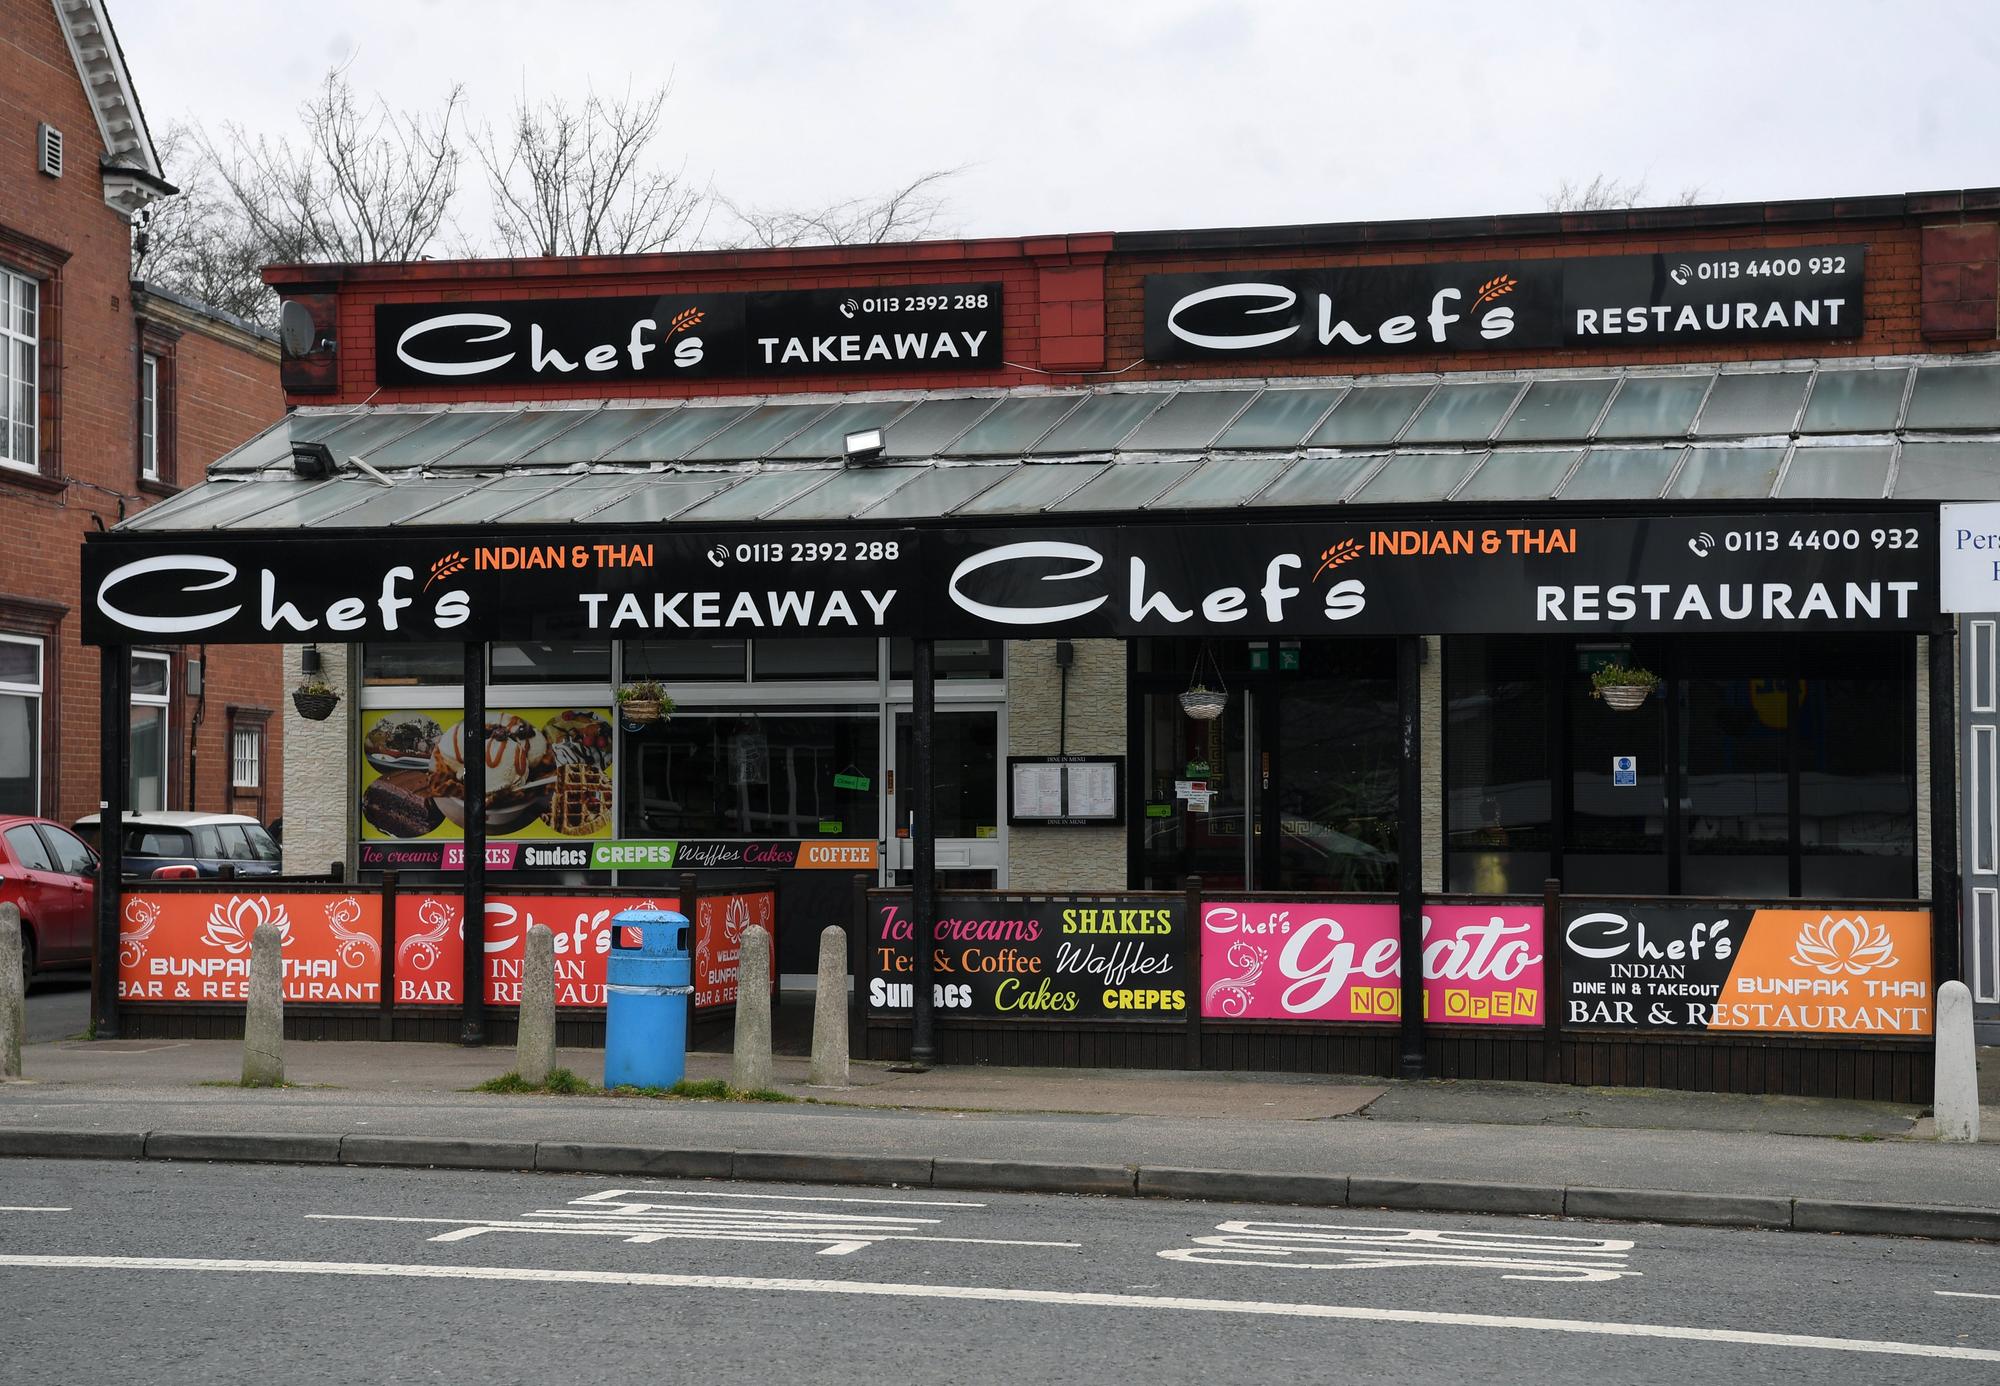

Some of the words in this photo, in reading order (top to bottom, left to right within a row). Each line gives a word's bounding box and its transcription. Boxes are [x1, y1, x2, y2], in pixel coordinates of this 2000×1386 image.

[1697, 260, 1741, 280] 0113
[1746, 258, 1801, 278] 4400
[1808, 256, 1847, 275] 932
[862, 297, 899, 313] 0113
[905, 296, 949, 312] 2392
[953, 294, 989, 310] 288
[1576, 297, 1846, 336] RESTAURANT
[758, 330, 987, 364] TAKEAWAY
[735, 542, 783, 563] 0113
[790, 541, 847, 562] 2392
[854, 540, 900, 560] 288
[1369, 529, 1467, 556] INDIAN
[1480, 528, 1502, 554] &
[1506, 528, 1577, 554] THAI
[1724, 530, 1779, 551] 0113
[1788, 529, 1860, 550] 4400
[1871, 528, 1919, 549] 932
[474, 545, 565, 570] INDIAN
[572, 545, 589, 568] &
[593, 543, 654, 568] THAI
[579, 588, 897, 629] TAKEAWAY
[1536, 581, 1919, 622] RESTAURANT
[363, 847, 384, 862] Ice
[387, 849, 439, 862] creams
[525, 847, 586, 866] Sundaes
[596, 846, 671, 863] CREPES
[679, 845, 740, 866] Waffles
[743, 844, 794, 863] Cakes
[809, 847, 870, 863] COFFEE
[934, 917, 1044, 941] creams
[1062, 909, 1172, 934] SHAKES
[934, 949, 955, 972] &
[962, 947, 1042, 973] Coffee
[1055, 941, 1173, 986] Waffles
[1279, 915, 1543, 1013] Geato
[1610, 963, 1686, 979] INDIAN
[174, 981, 190, 997] &
[400, 981, 454, 1001] BAR
[695, 991, 712, 1006] BAR
[870, 977, 972, 1008] Sunaes
[994, 977, 1080, 1012] Cakes
[1102, 989, 1186, 1010] CREPES
[1573, 982, 1606, 995] DINE
[1611, 982, 1626, 995] IN
[1632, 983, 1642, 995] &
[1648, 984, 1719, 997] TAKEOUT
[1738, 976, 1849, 996] BUNPAK
[1863, 980, 1925, 998] THAI
[1354, 990, 1424, 1012] NO
[1447, 991, 1536, 1015] OPEN
[1568, 1001, 1638, 1024] BAR
[1648, 1003, 1677, 1025] &
[1686, 1003, 1927, 1031] RESTAURANT
